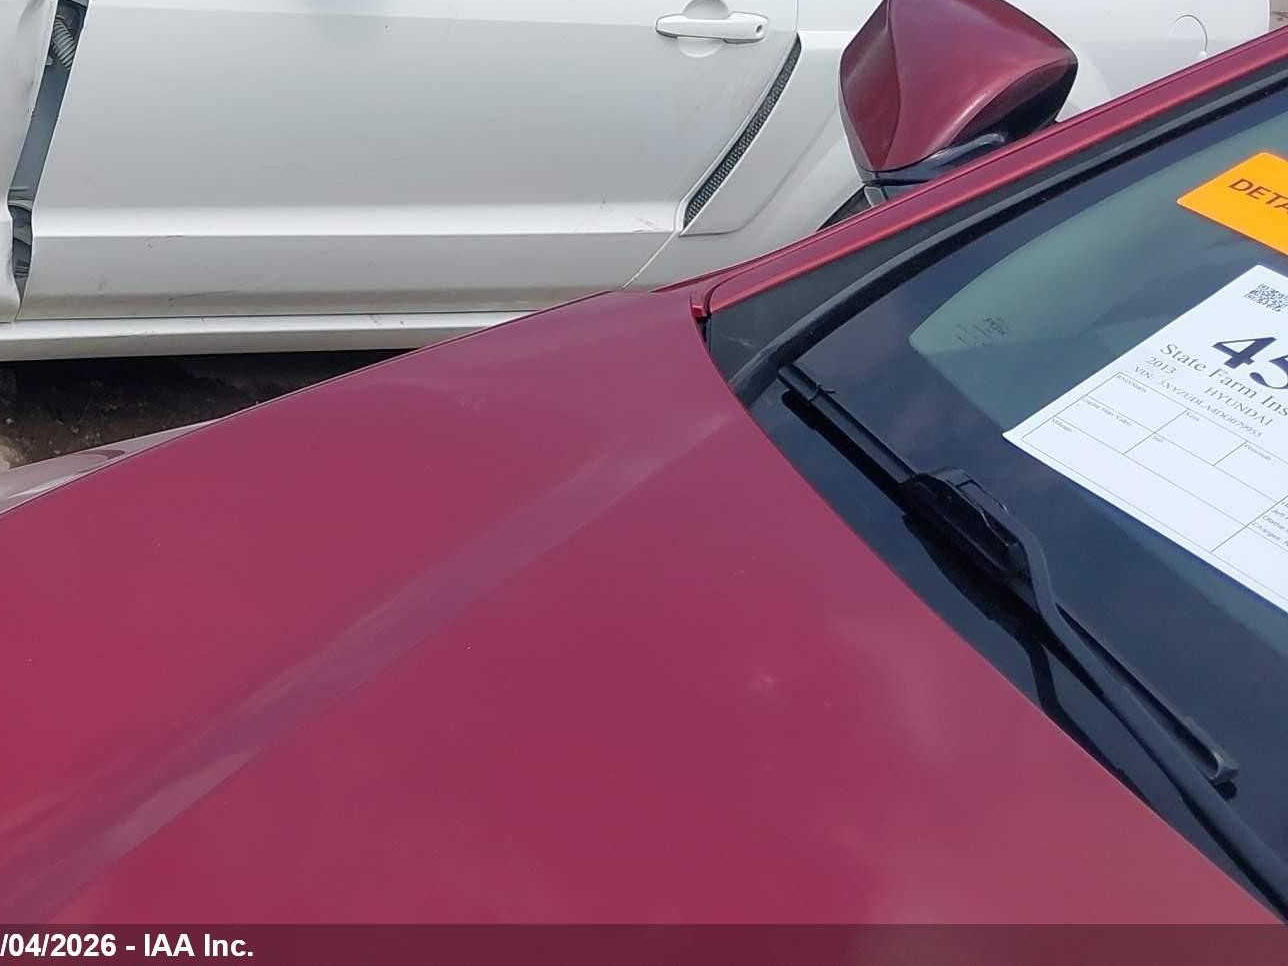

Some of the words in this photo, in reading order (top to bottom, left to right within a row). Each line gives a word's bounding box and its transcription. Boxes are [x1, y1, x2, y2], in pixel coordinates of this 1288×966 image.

[1145, 356, 1177, 375] 2013
[1203, 386, 1273, 426] HYUNDAI
[1160, 343, 1207, 372] State
[1208, 367, 1258, 400] Farm
